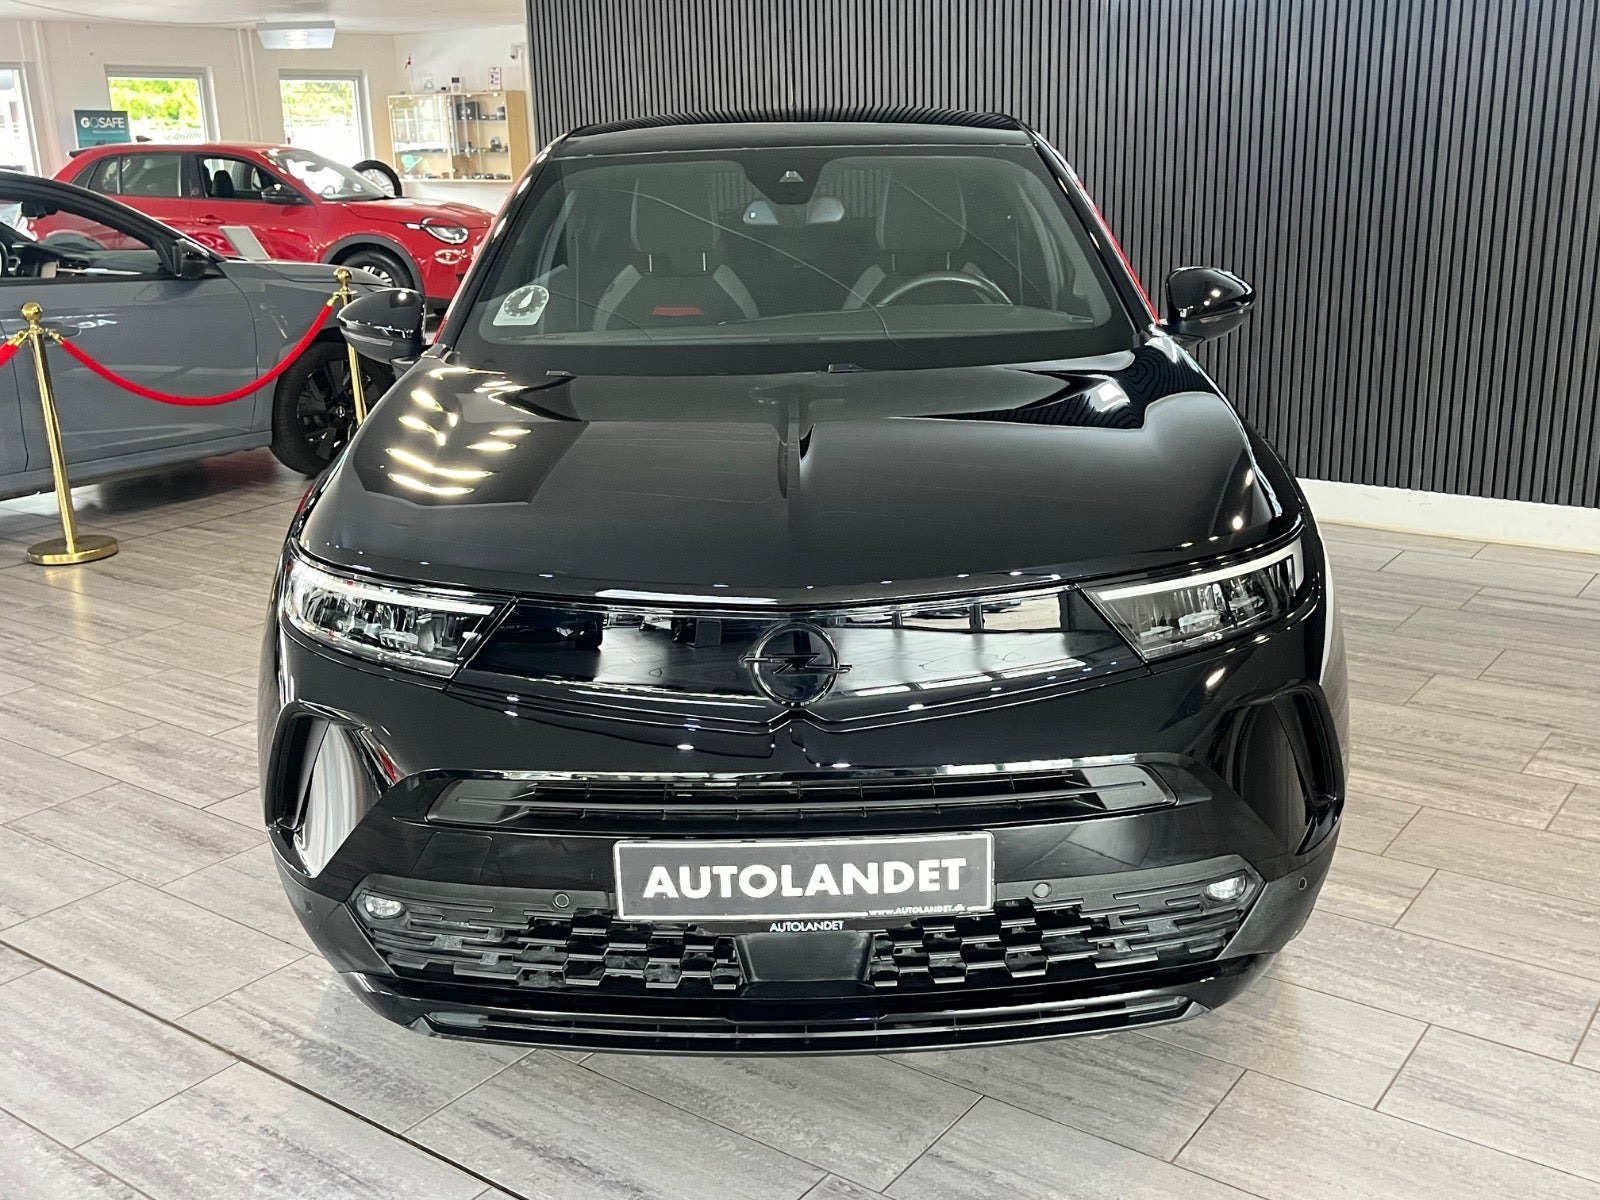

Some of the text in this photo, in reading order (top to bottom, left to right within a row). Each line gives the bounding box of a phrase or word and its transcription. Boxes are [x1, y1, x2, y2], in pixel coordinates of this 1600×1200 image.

[80, 117, 125, 128] GOSAFE
[643, 858, 967, 898] AUTOLANDET
[868, 904, 966, 916] www.AUTOLANDET.dk
[769, 920, 845, 933] AUTOLANDET
